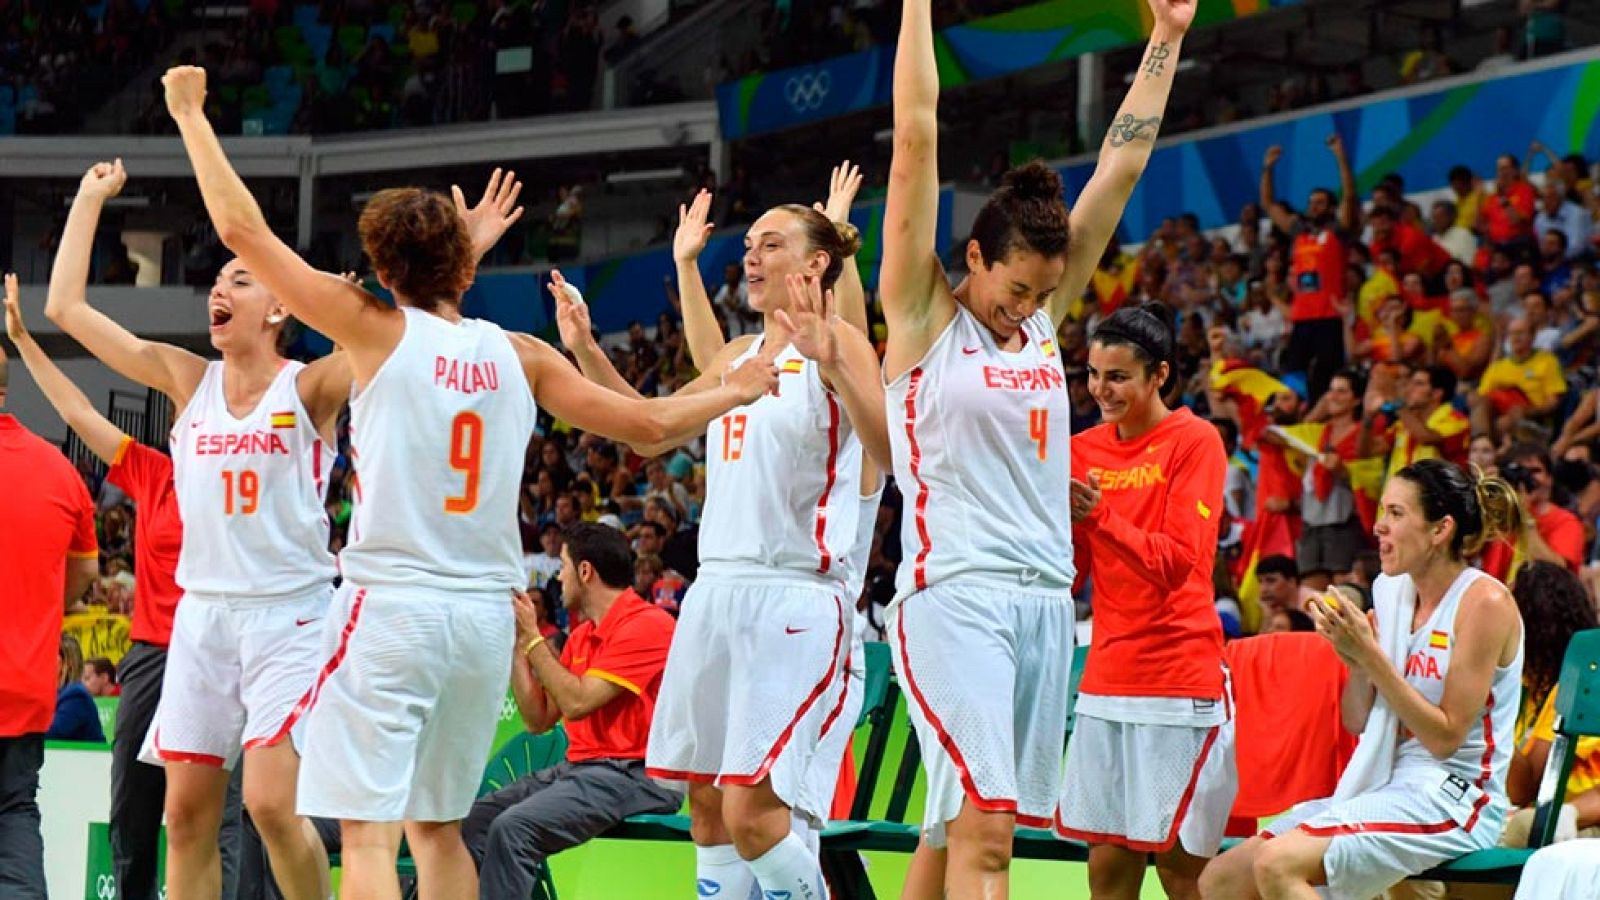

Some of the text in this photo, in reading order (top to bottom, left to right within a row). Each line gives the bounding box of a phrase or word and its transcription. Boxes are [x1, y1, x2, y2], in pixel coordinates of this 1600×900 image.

[434, 354, 499, 394] PALAU
[195, 429, 289, 455] ESPAÑA
[722, 414, 748, 461] 13
[1029, 408, 1049, 462] 4
[443, 410, 483, 514] 9
[221, 469, 259, 515] 19
